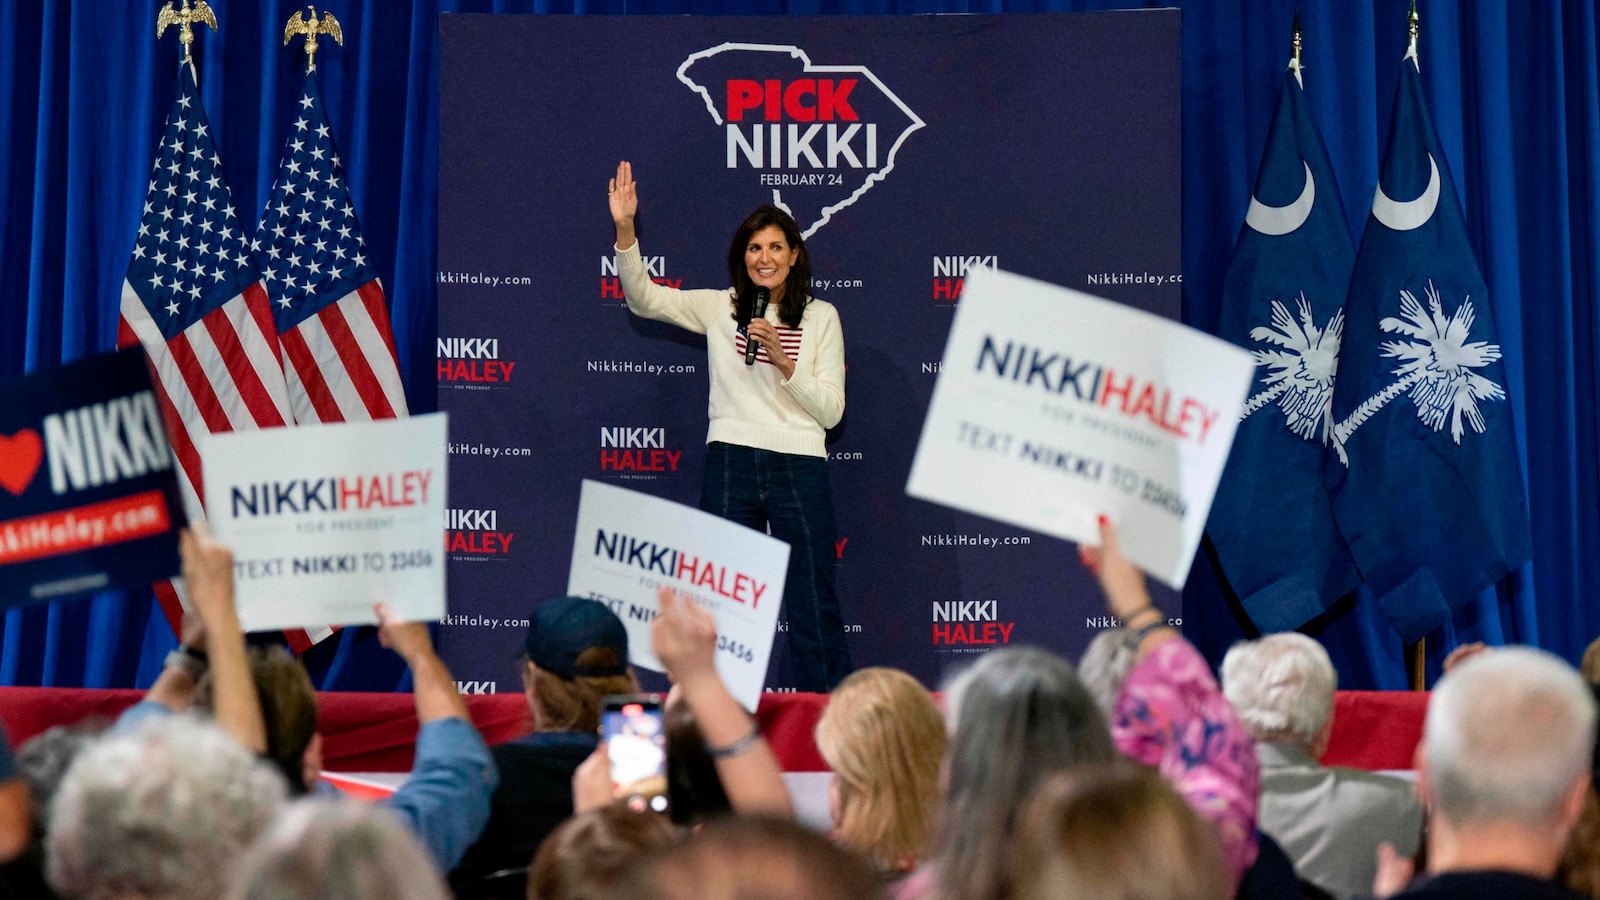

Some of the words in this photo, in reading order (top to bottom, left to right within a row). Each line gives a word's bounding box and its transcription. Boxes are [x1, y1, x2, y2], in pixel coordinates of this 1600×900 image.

[727, 79, 859, 121] PICK
[727, 124, 877, 168] NIKKI
[761, 174, 824, 185] FEBRUARY
[828, 174, 843, 185] 24
[601, 256, 665, 276] NKI
[437, 272, 531, 287] ikkiHaley.com
[811, 276, 863, 291] ley.com
[437, 338, 498, 360] NIKKI
[437, 360, 515, 382] HALEY
[587, 360, 696, 376] NikkiHaley.com
[44, 390, 171, 494] NIKKI
[601, 427, 664, 448] NIKKI
[445, 443, 531, 458] kiHaley.com
[601, 450, 682, 472] HALEY
[1020, 441, 1103, 482] NIKKI
[922, 533, 1031, 548] NikkiHaley.com
[235, 557, 284, 579] TEXT
[292, 554, 356, 575] NIKKI
[363, 552, 385, 572] TO
[933, 600, 997, 621] NIKKI
[933, 623, 1015, 645] HALEY
[714, 633, 754, 662] 3456
